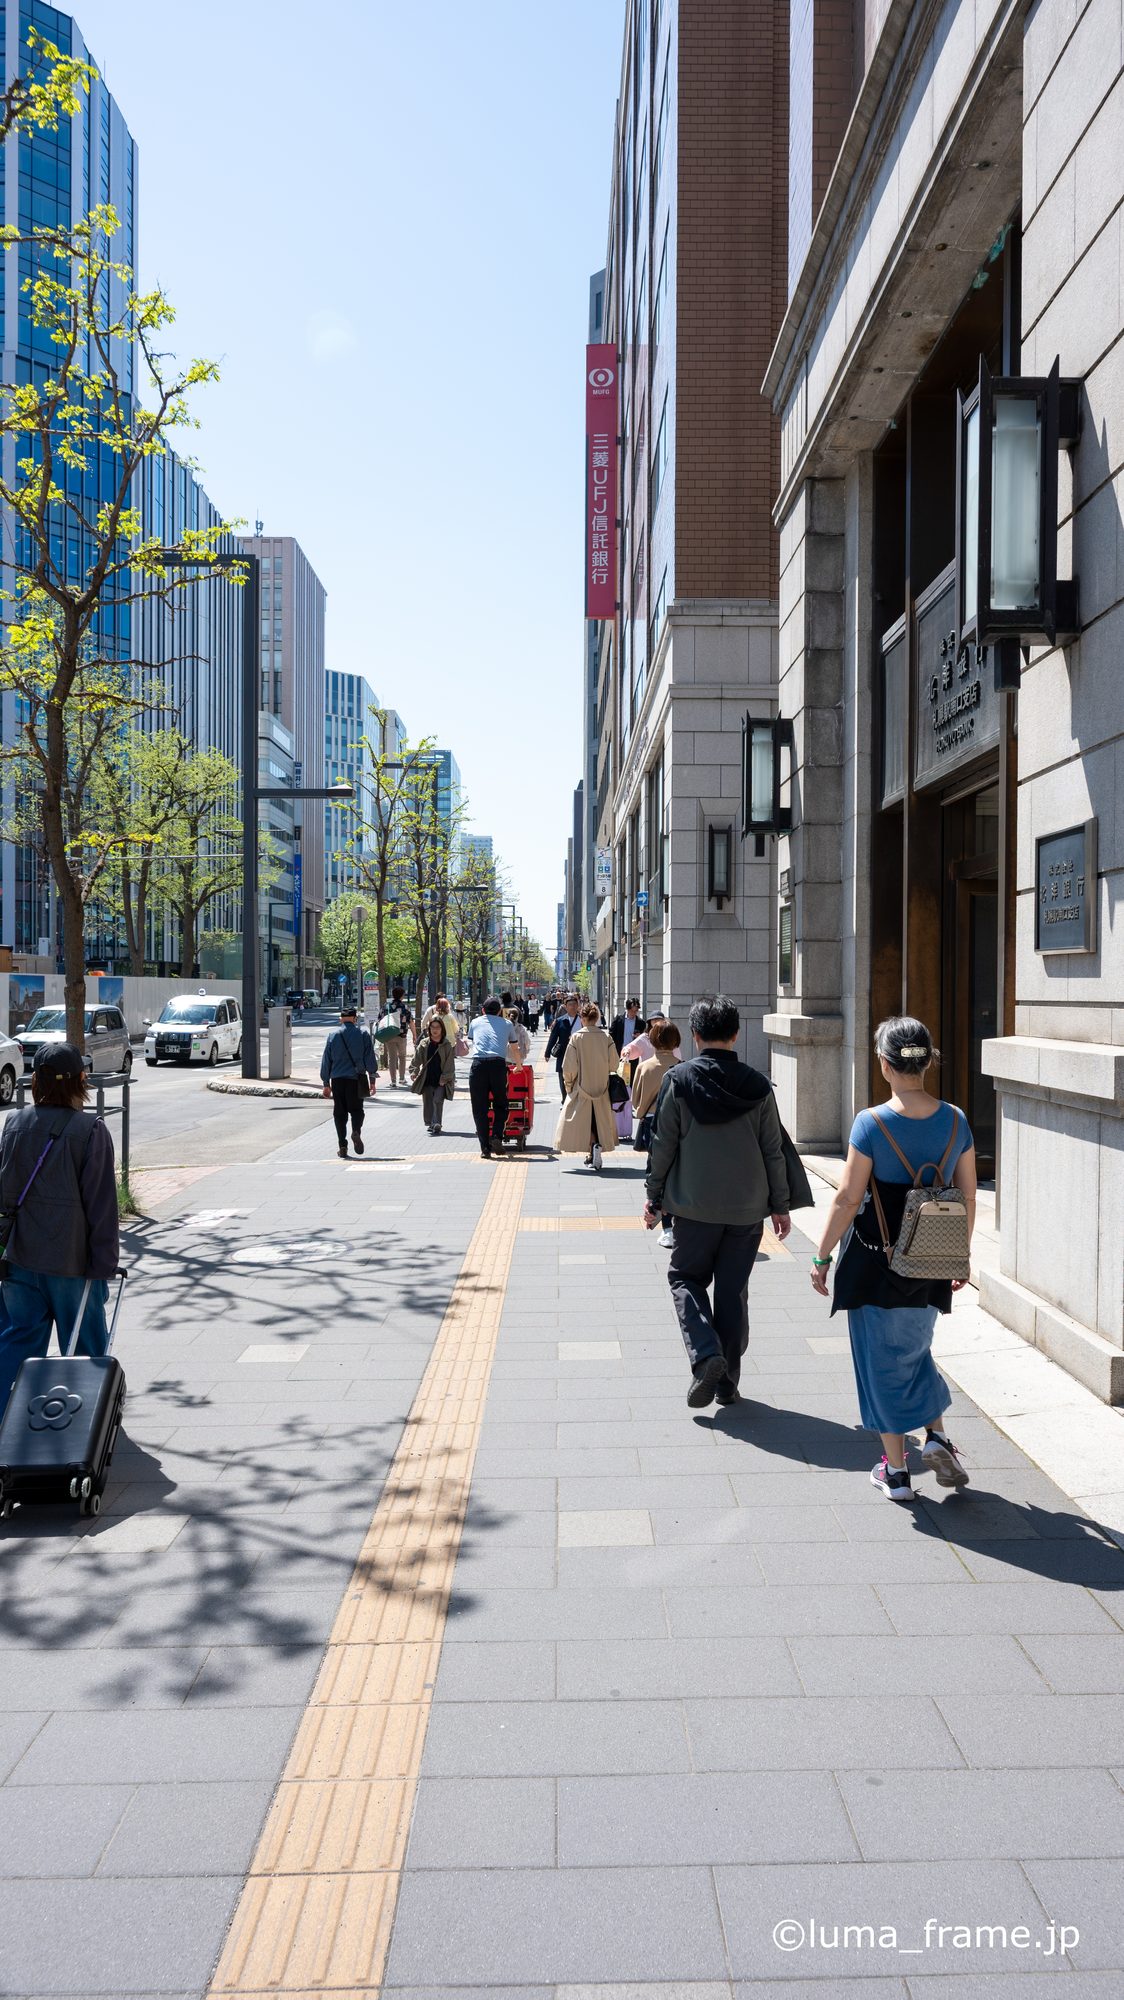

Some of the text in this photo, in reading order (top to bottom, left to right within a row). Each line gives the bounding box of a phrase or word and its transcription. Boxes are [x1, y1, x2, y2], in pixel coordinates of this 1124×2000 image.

[591, 433, 609, 585] 三菱UFJ信託銀行
